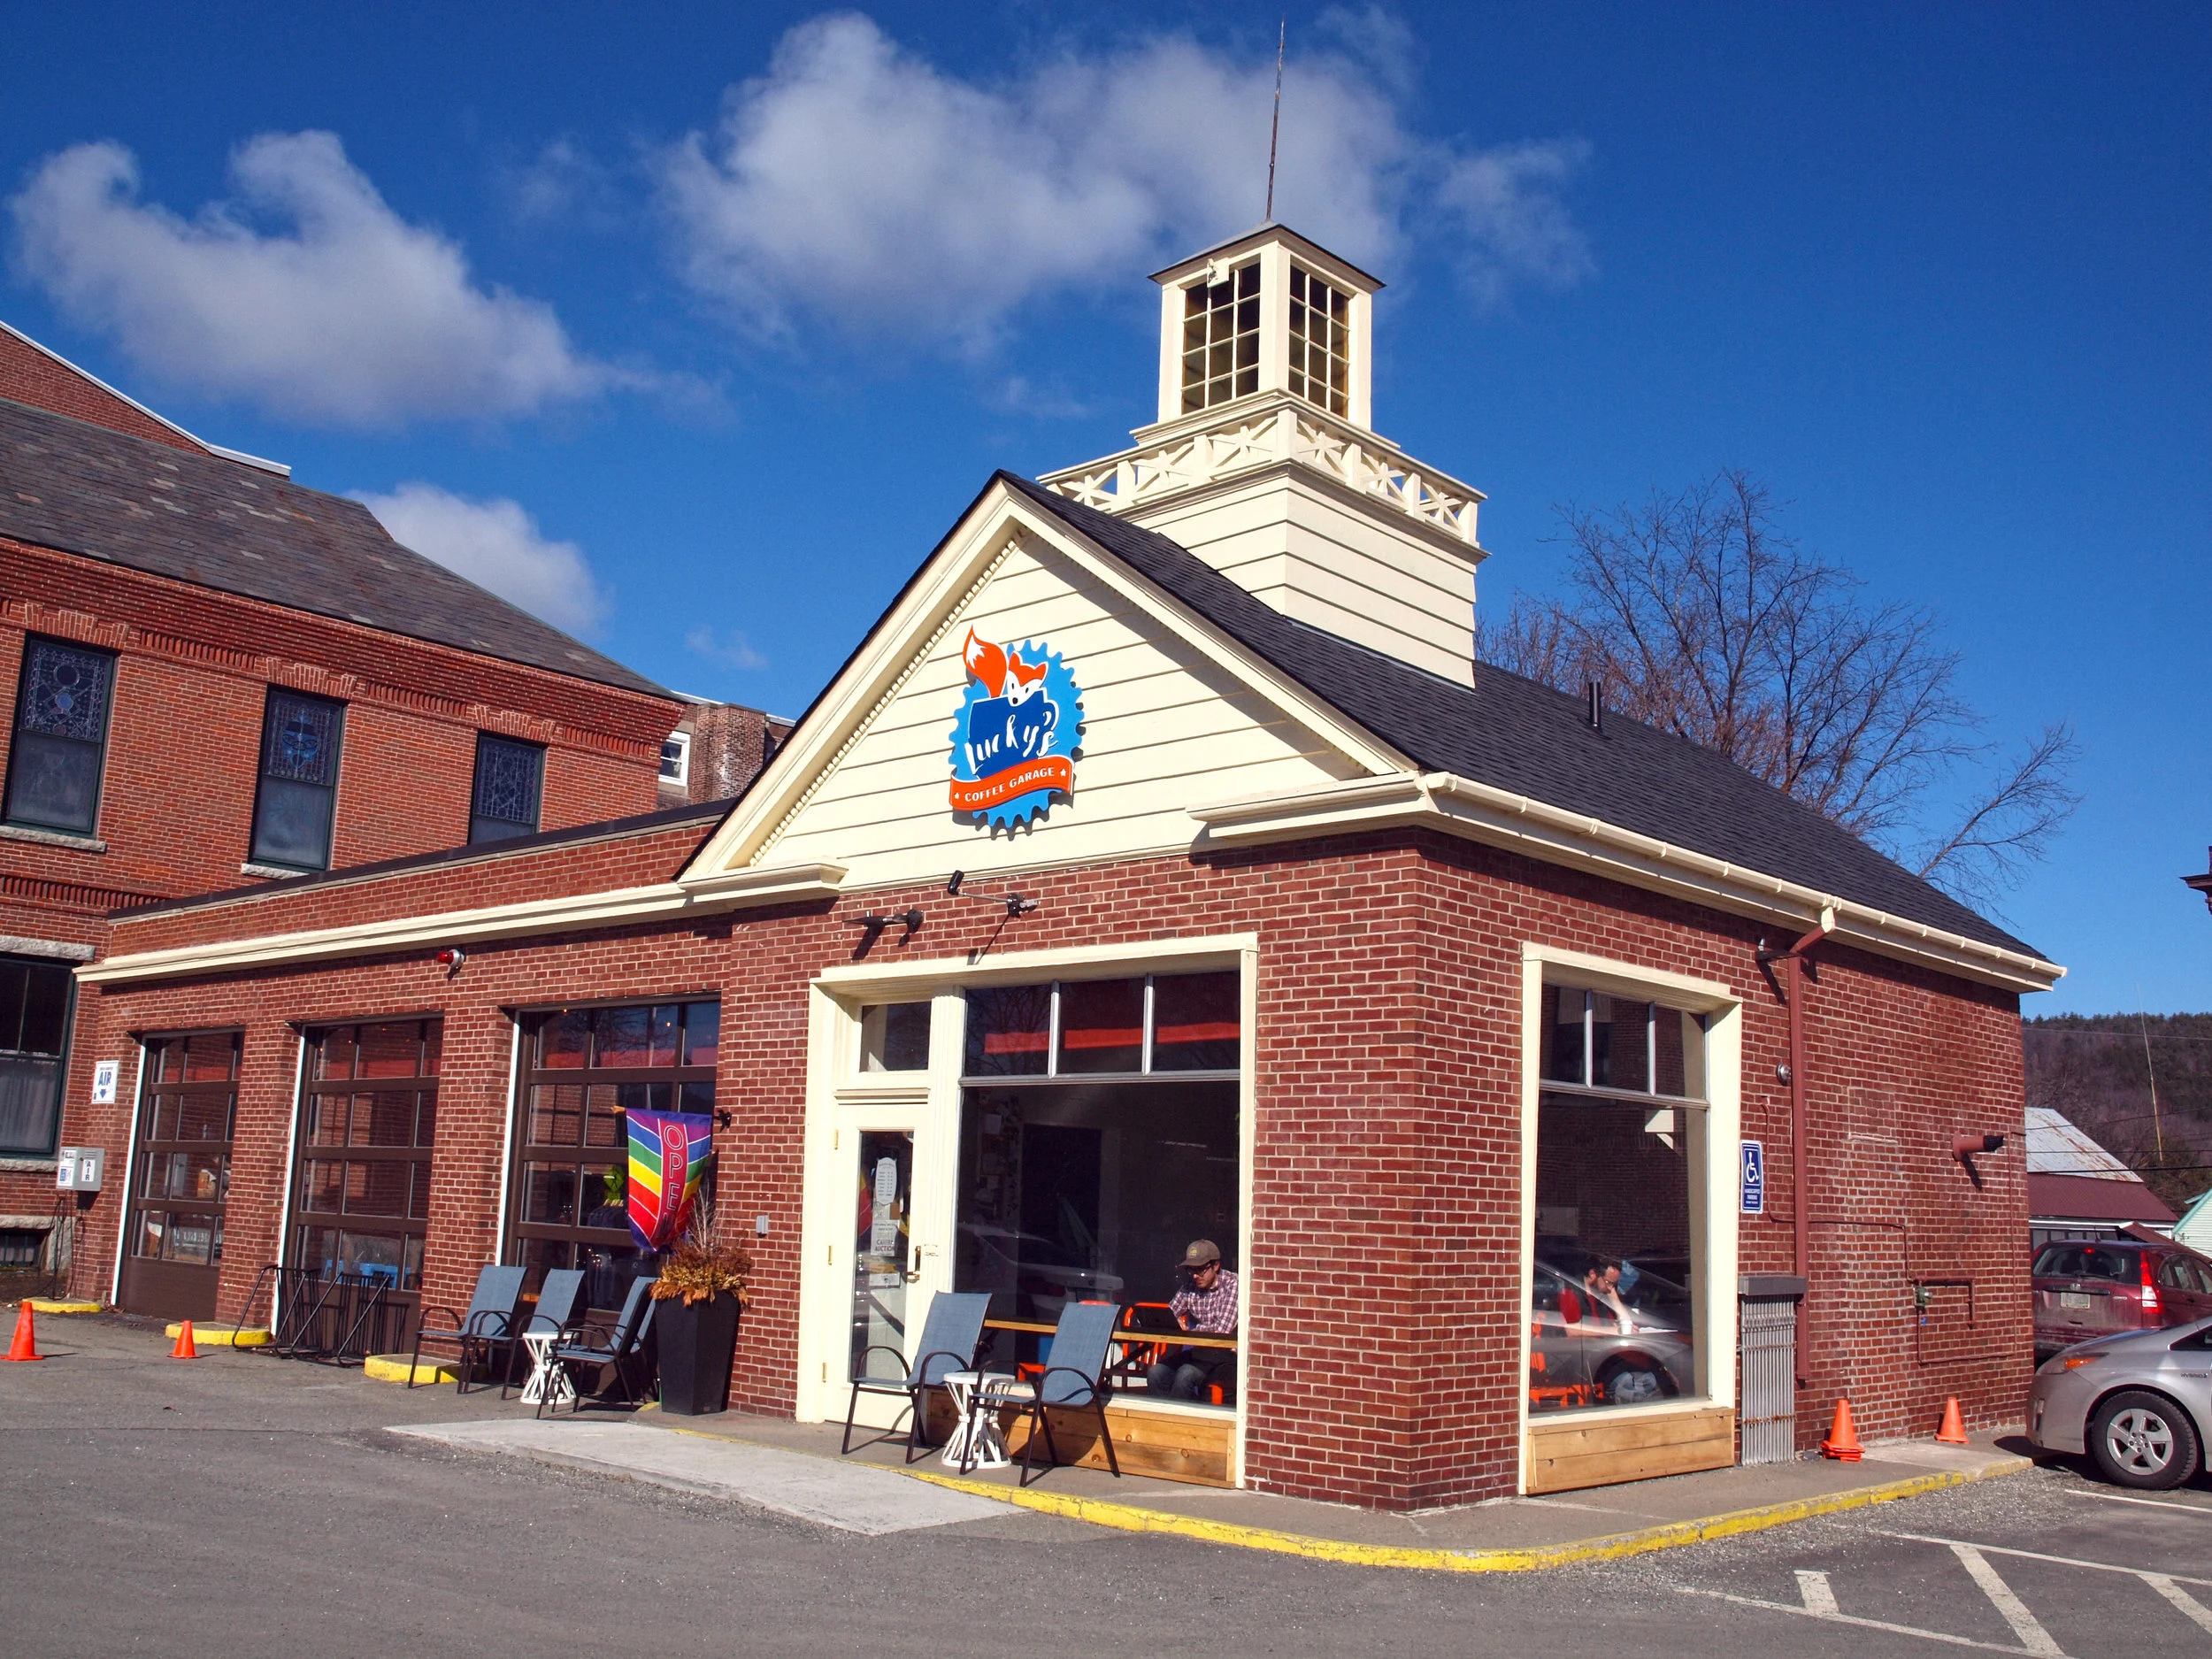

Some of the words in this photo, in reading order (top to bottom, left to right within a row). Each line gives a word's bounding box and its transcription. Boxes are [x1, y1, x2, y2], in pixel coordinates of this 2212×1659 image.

[964, 710, 1058, 775] Lucky's
[964, 782, 1006, 803] COFFEE
[1009, 766, 1055, 788] GARAGE
[98, 1071, 112, 1087] AIR
